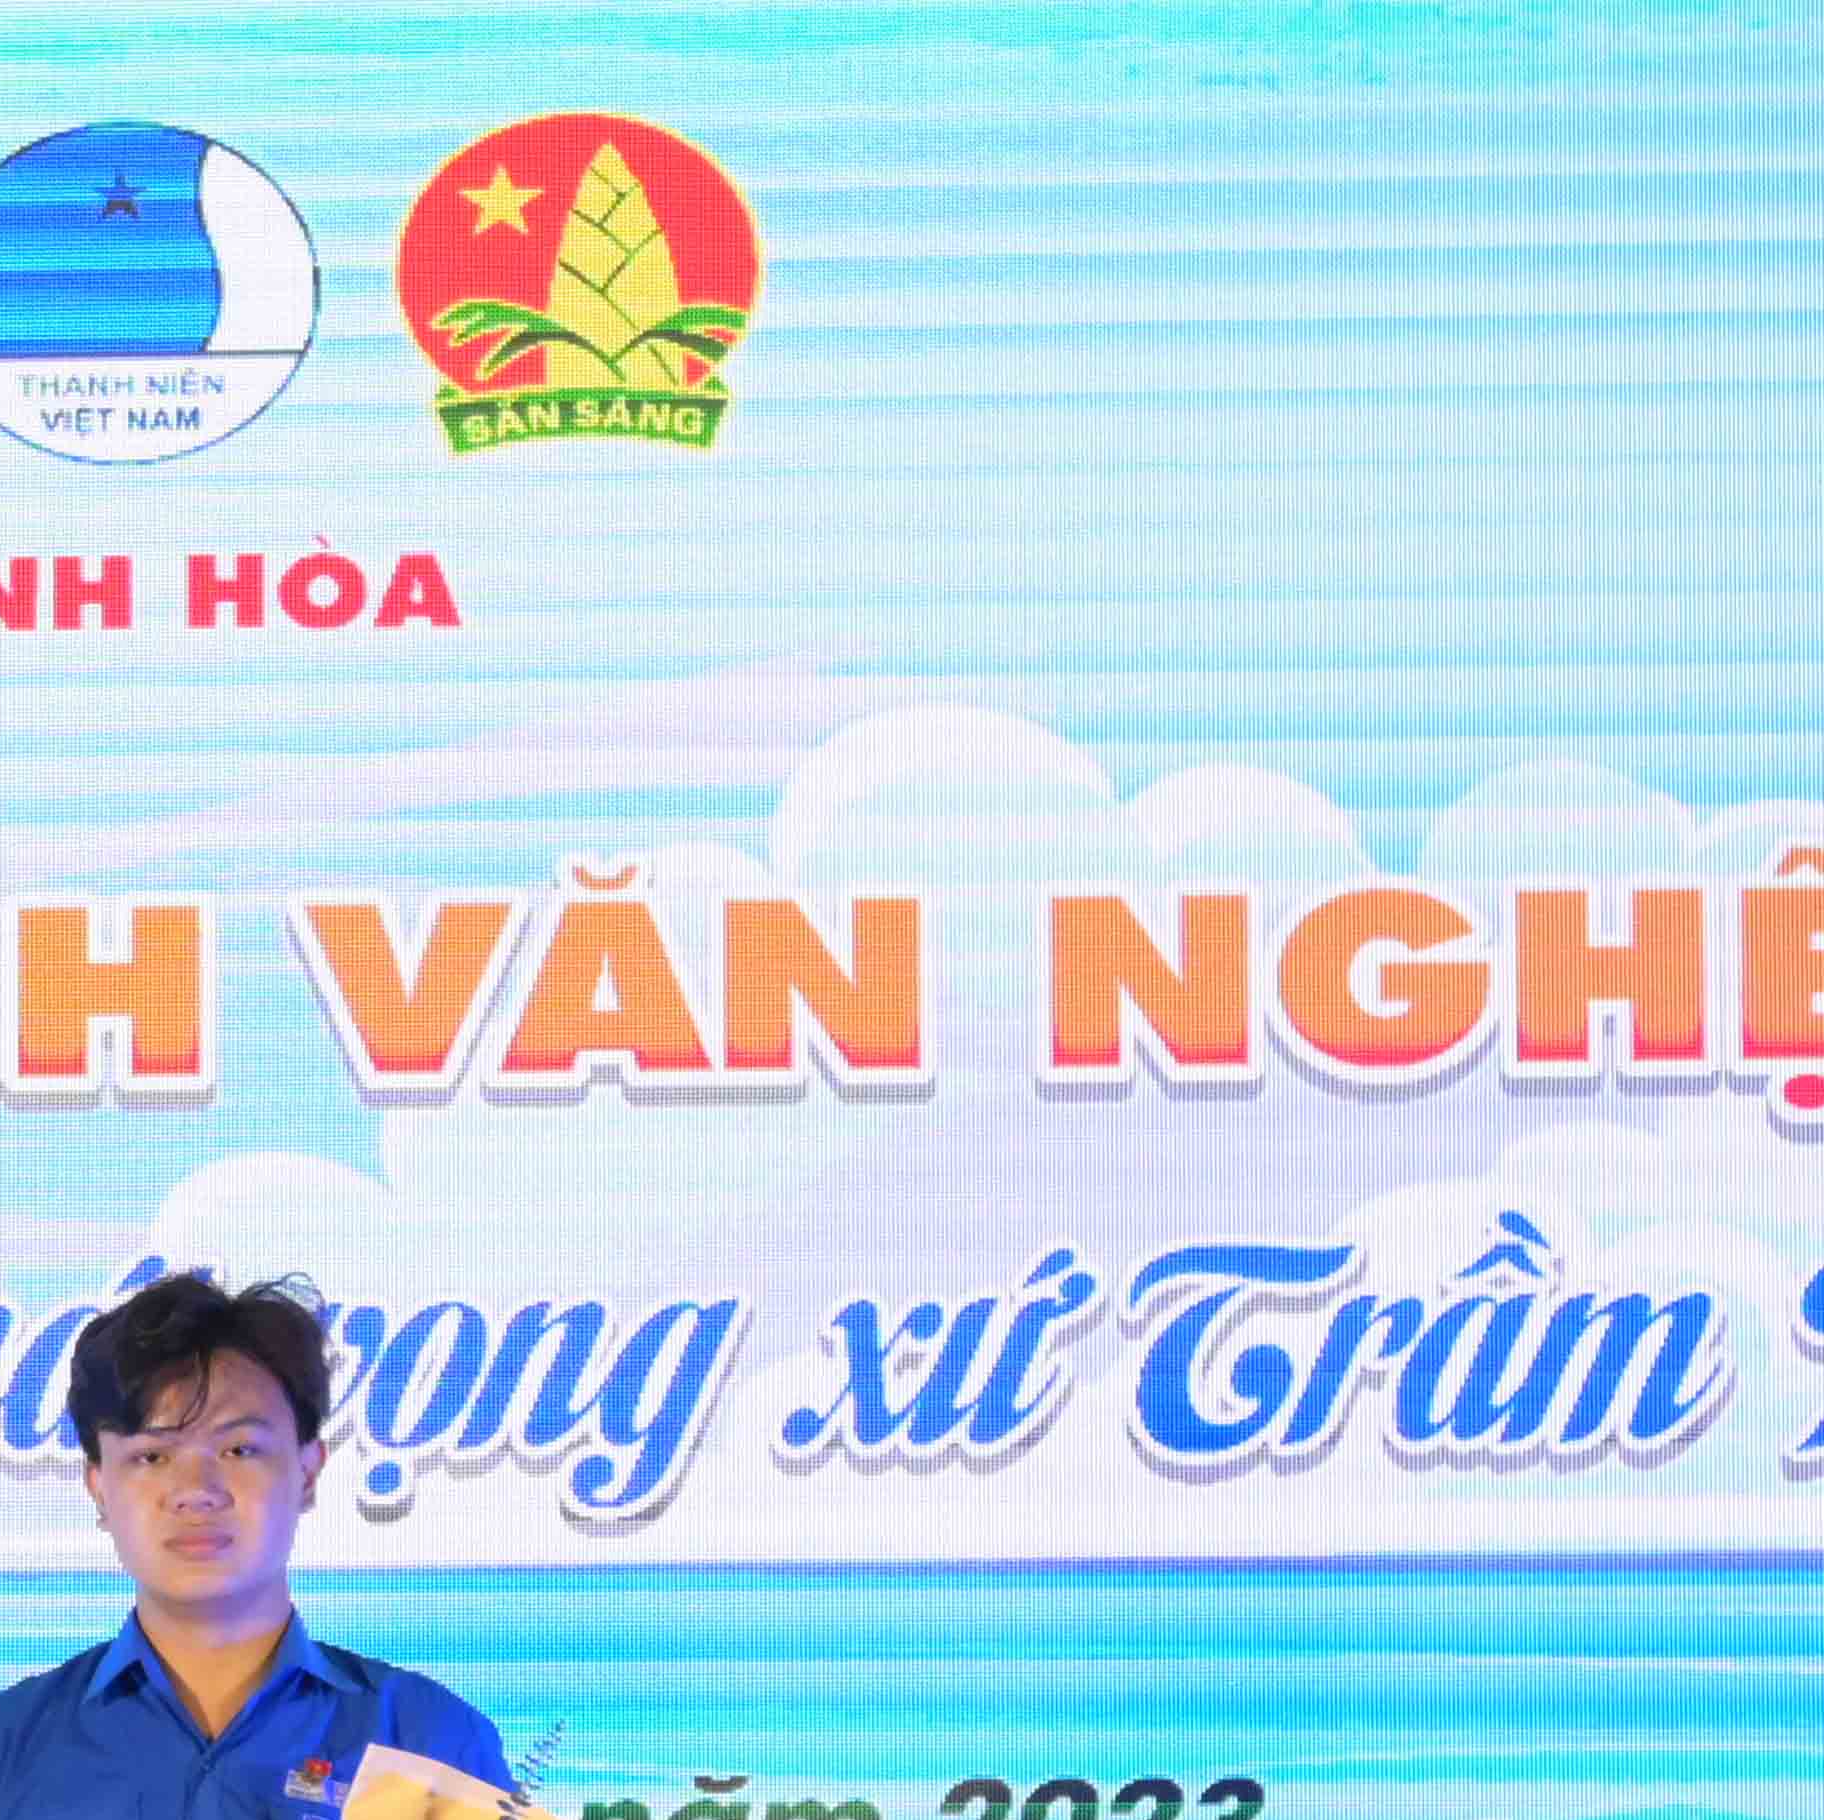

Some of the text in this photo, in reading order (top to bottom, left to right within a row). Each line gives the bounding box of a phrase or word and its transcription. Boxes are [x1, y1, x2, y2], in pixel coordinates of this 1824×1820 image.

[16, 367, 227, 399] THANH NIÊN
[127, 405, 202, 432] NAM
[186, 534, 462, 630] HÒA
[309, 867, 924, 1074] VĂN
[781, 1246, 1096, 1447] xứ
[1128, 1209, 1714, 1455] Trầm
